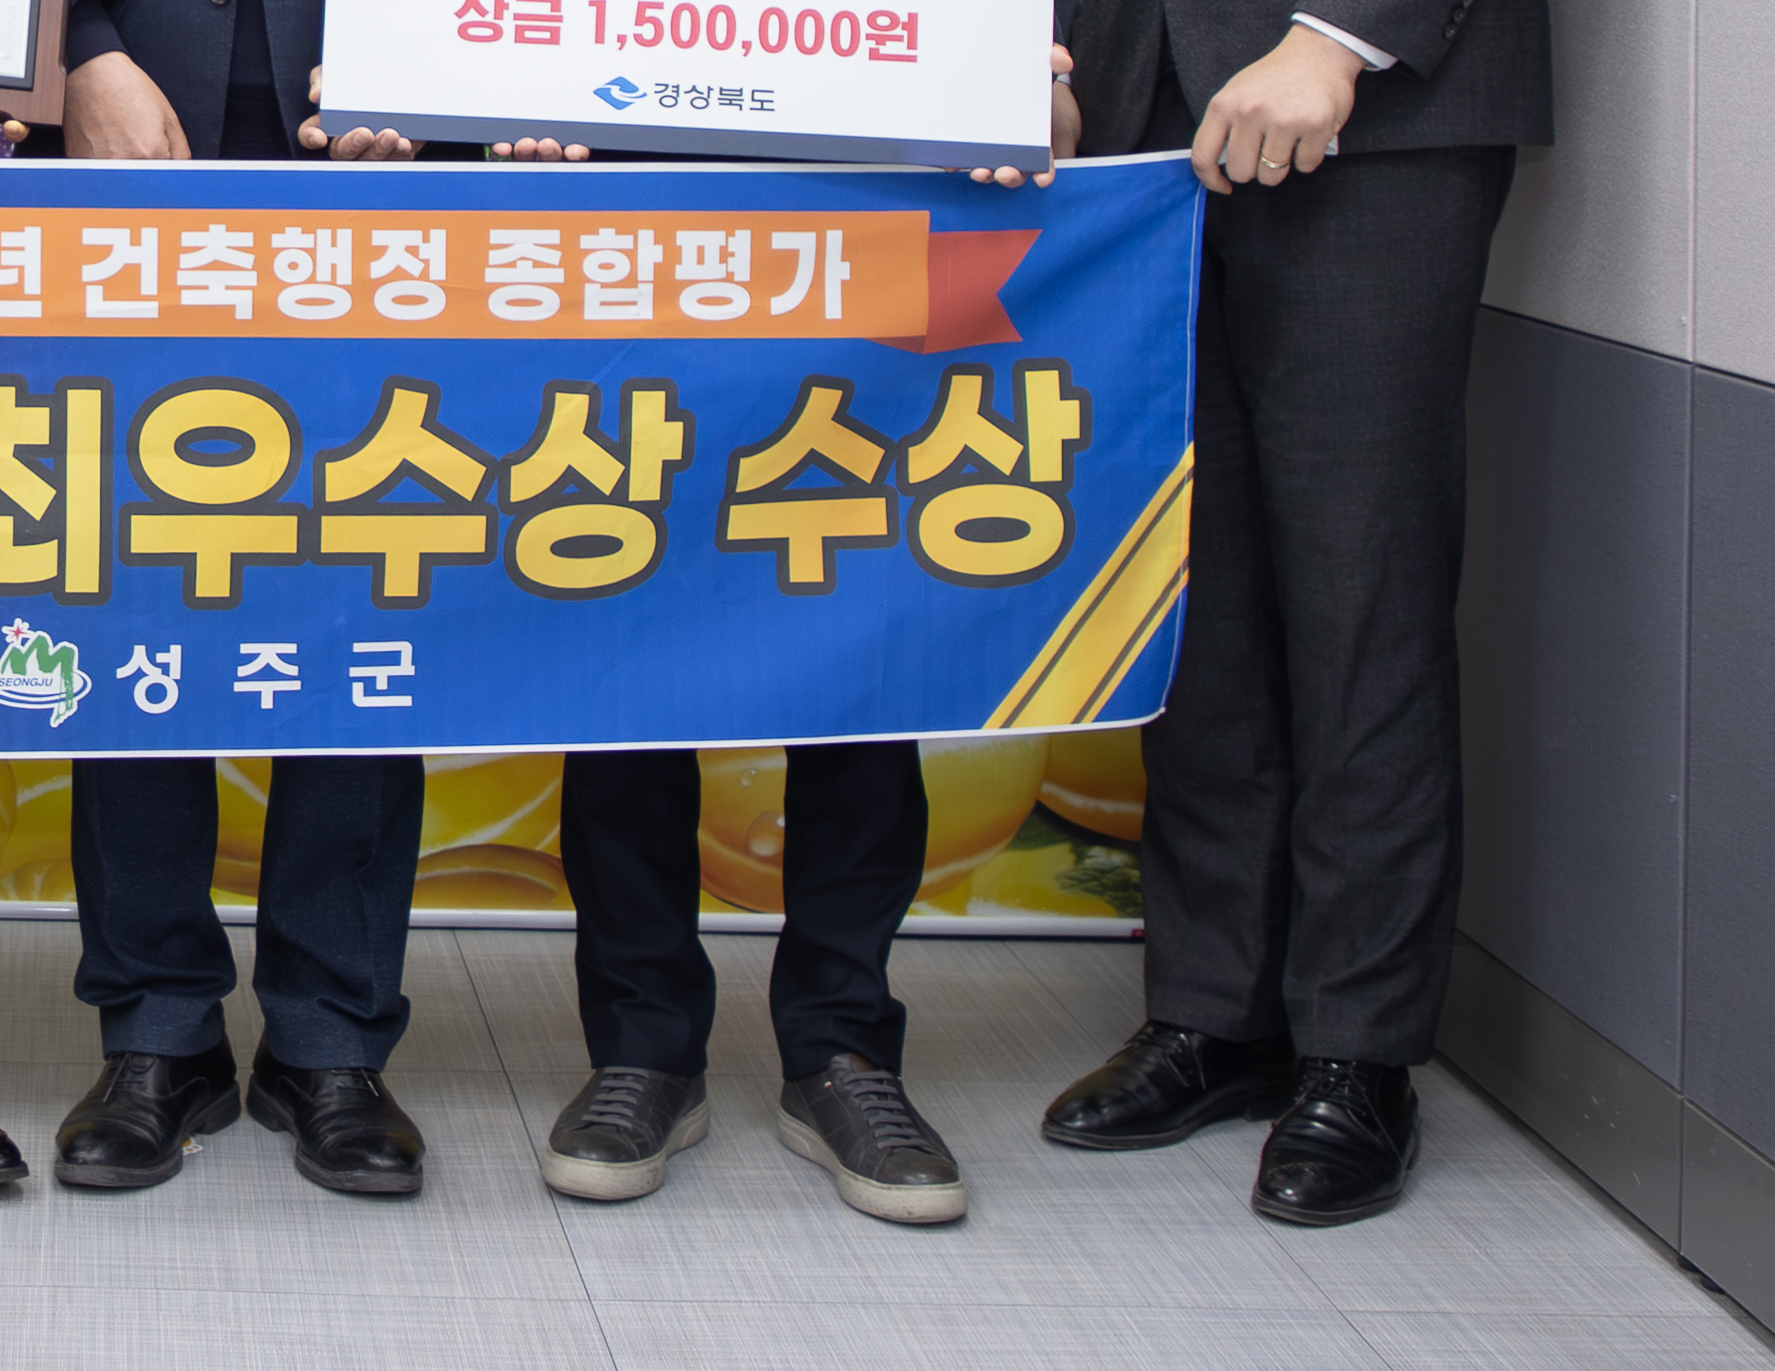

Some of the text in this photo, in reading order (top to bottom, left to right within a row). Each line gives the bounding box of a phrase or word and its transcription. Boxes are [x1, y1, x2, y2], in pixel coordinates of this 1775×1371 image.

[653, 82, 776, 113] 경상북도
[80, 223, 448, 322] 건축행정
[483, 227, 852, 322] 종합평가
[725, 369, 1083, 584] 수상
